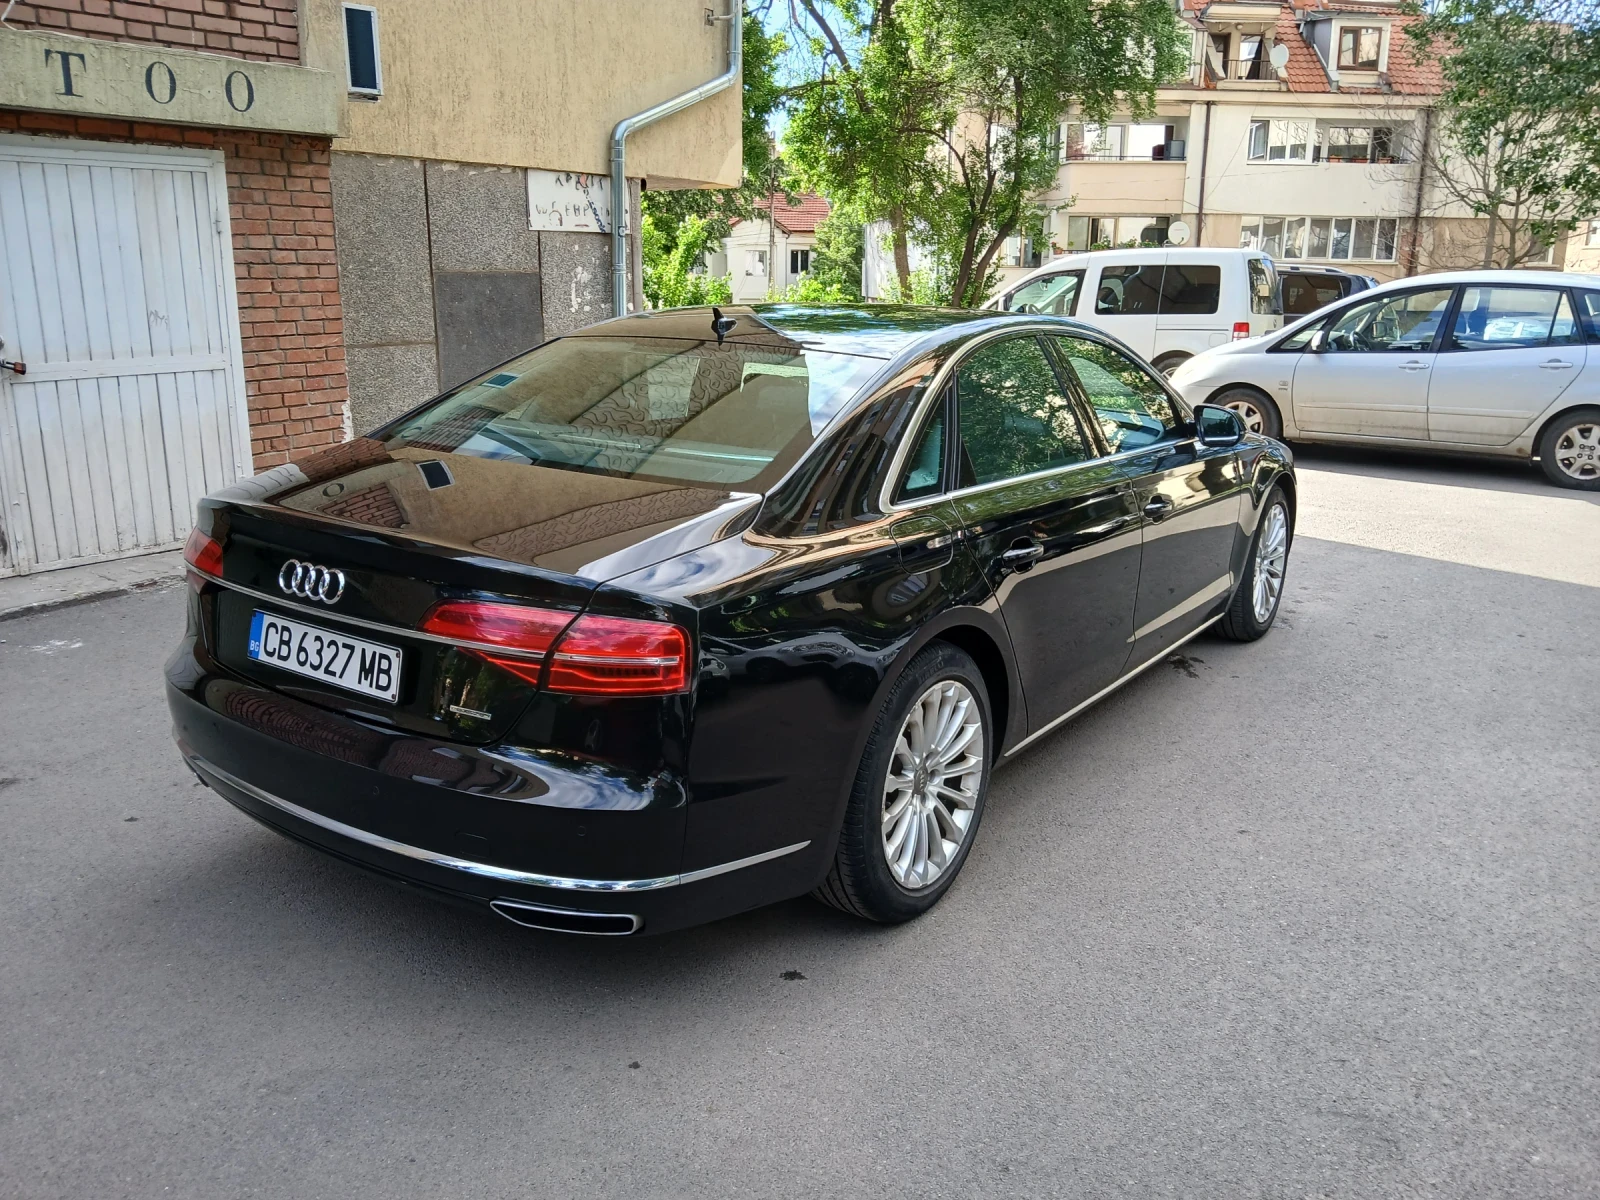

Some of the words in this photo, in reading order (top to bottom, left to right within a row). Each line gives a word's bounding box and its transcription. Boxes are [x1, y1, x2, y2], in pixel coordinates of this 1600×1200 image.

[250, 639, 260, 652] BG
[263, 621, 293, 663] CB
[296, 631, 356, 680] 6327
[357, 647, 393, 692] MB
